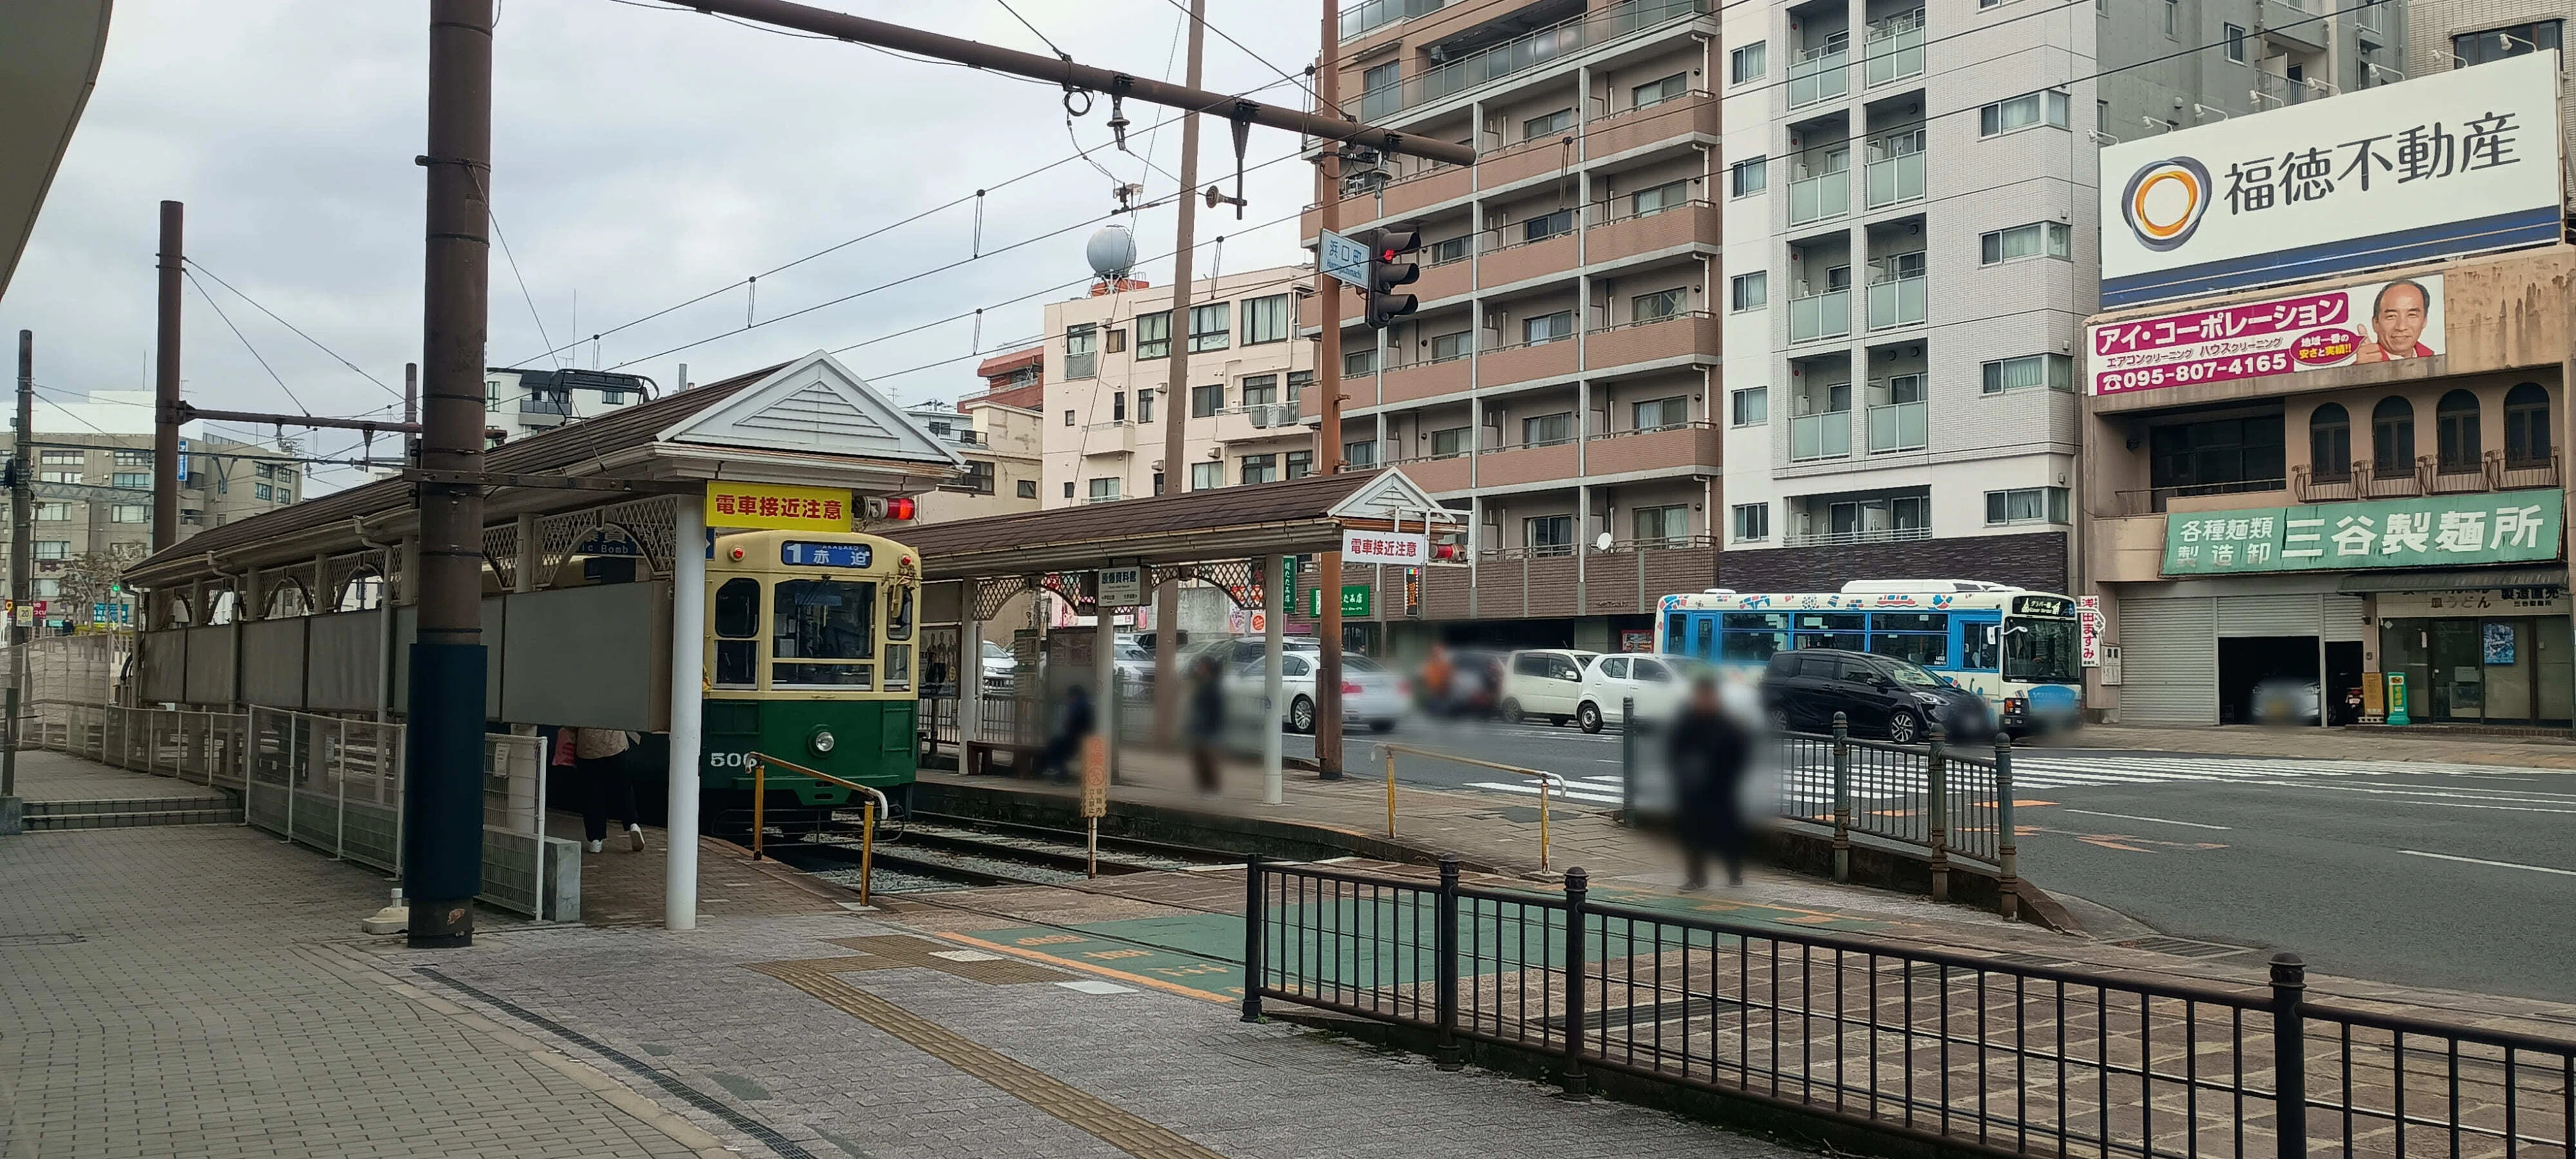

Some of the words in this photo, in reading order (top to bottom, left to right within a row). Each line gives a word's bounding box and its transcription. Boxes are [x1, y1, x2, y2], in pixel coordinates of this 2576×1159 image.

[2224, 111, 2521, 216] 福徳不動産
[1329, 240, 1362, 268] 浜口町
[2099, 297, 2345, 353] アイ・コーポレーション
[2107, 348, 2193, 368] エアコンクリーニング
[2199, 337, 2282, 358] ハウスクリーニング
[2301, 333, 2349, 348] 地域一番の
[2123, 353, 2287, 388] 095-807-4165
[715, 494, 842, 521] 電車接近注意
[2179, 516, 2274, 542] 各種麺類
[2282, 504, 2544, 558] 三谷製麺所
[601, 545, 629, 554] Bomb
[786, 543, 802, 563] 1
[813, 549, 867, 566] 赤迫
[1350, 538, 1417, 558] 電車接近注意
[2430, 596, 2492, 609] 皿うどん
